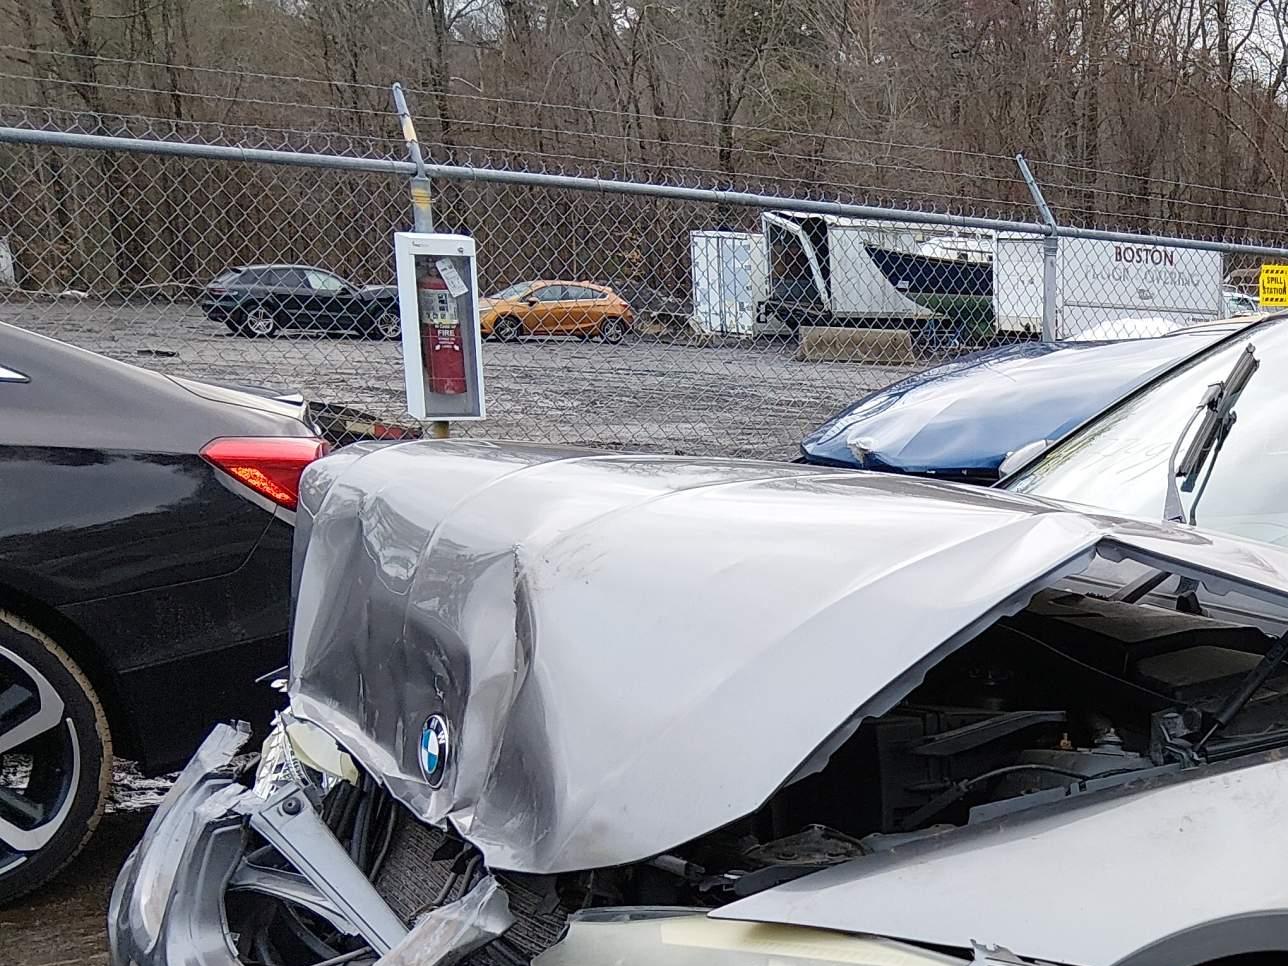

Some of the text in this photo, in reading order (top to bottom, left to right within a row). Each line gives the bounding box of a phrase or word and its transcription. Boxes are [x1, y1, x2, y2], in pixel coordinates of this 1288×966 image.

[1114, 246, 1174, 266] BOSTON
[1266, 276, 1283, 285] SPILL
[1262, 286, 1287, 295] STATION
